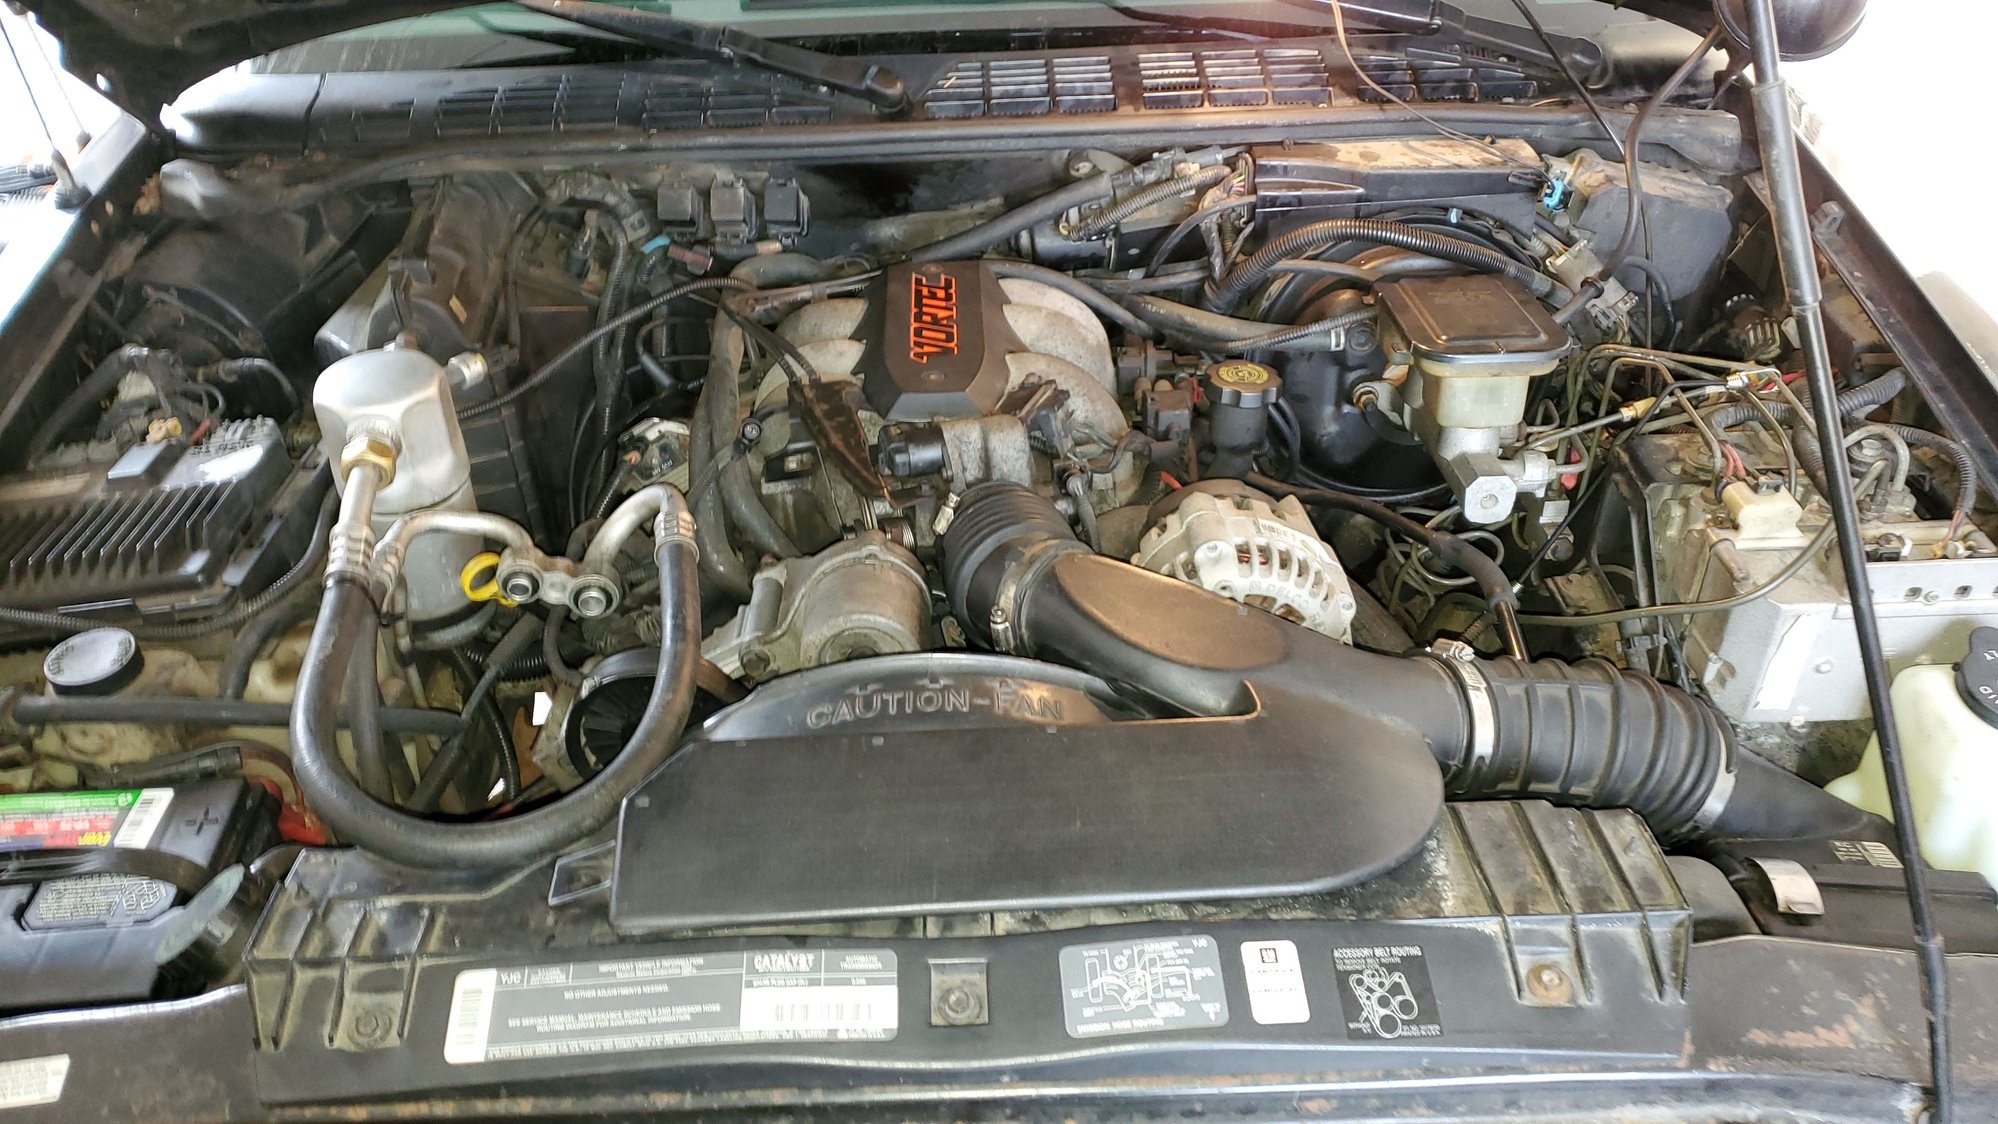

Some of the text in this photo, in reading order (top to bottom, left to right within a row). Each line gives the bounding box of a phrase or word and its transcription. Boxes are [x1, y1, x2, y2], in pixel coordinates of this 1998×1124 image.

[910, 271, 958, 364] VORTEC
[753, 952, 815, 969] CATALYST
[1333, 945, 1422, 959] ACCESSORY BELT ROUTING
